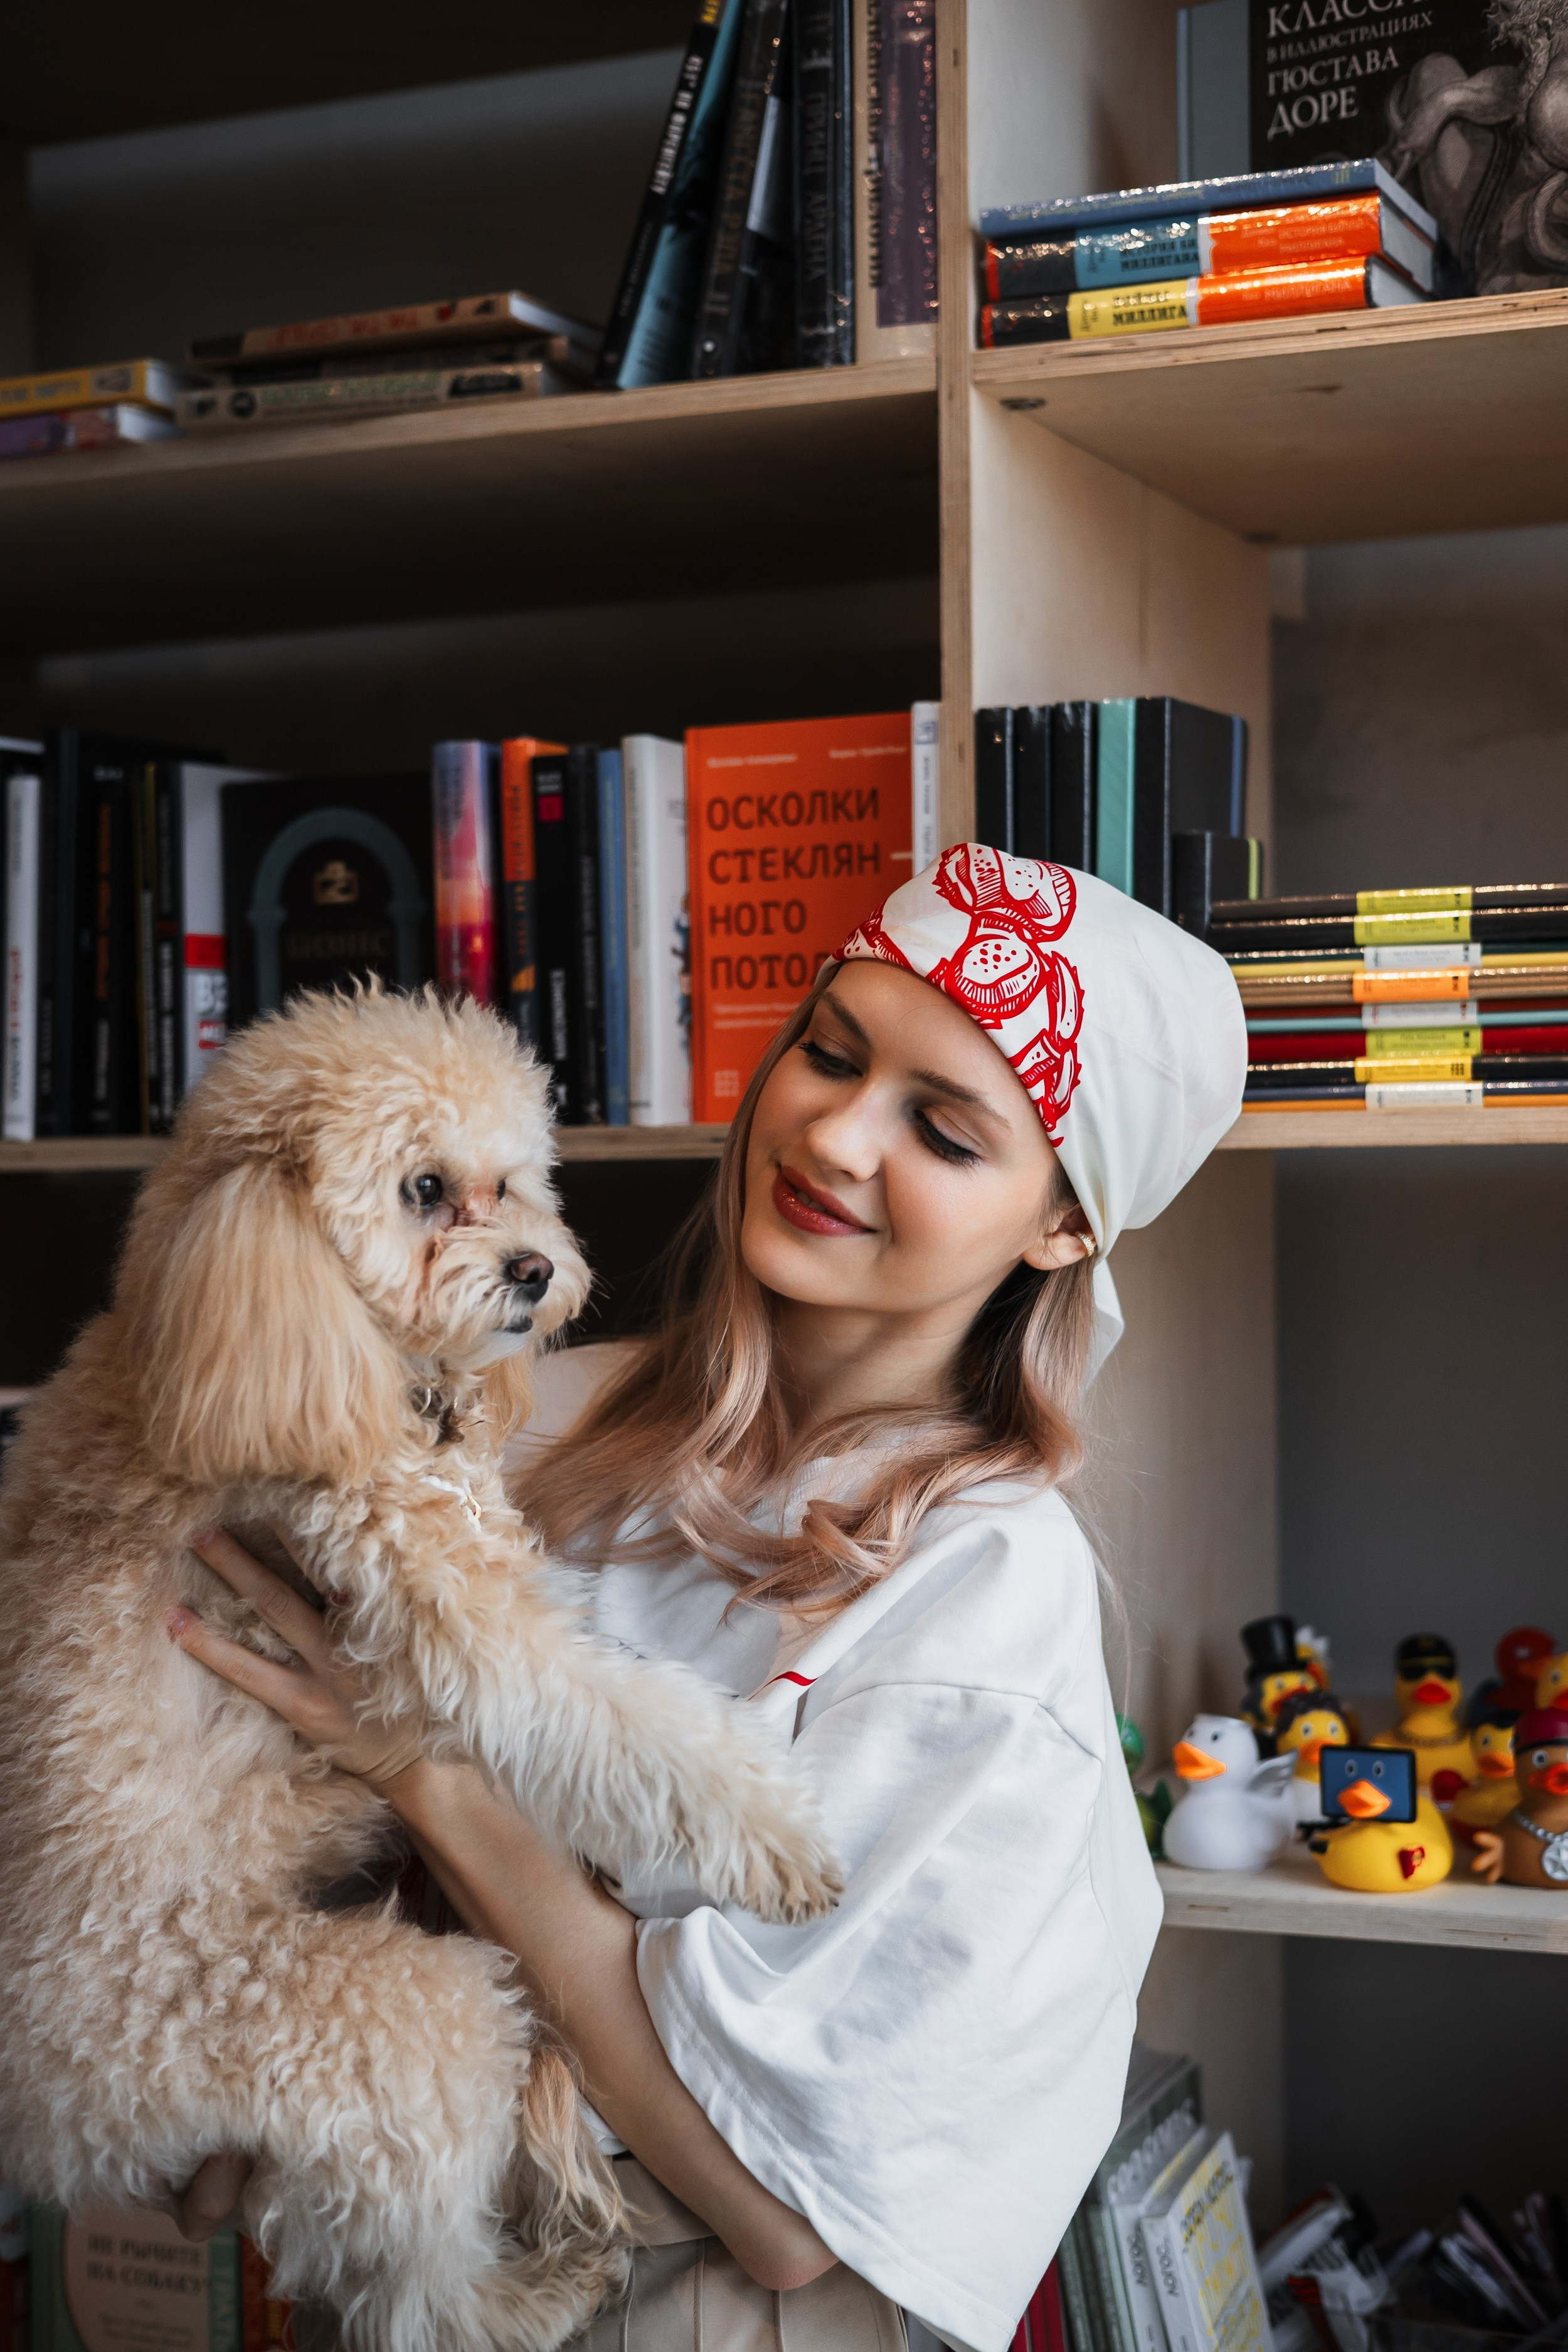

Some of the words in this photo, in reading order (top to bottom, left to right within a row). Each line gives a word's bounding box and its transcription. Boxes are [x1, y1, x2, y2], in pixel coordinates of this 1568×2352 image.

[1268, 45, 1399, 97] ГЮСТАВА
[1267, 85, 1360, 142] ДОРЕ
[706, 788, 879, 832] ОСКОЛКИ
[708, 842, 879, 885] СТЕКЛЯН
[709, 899, 807, 936] НОГО
